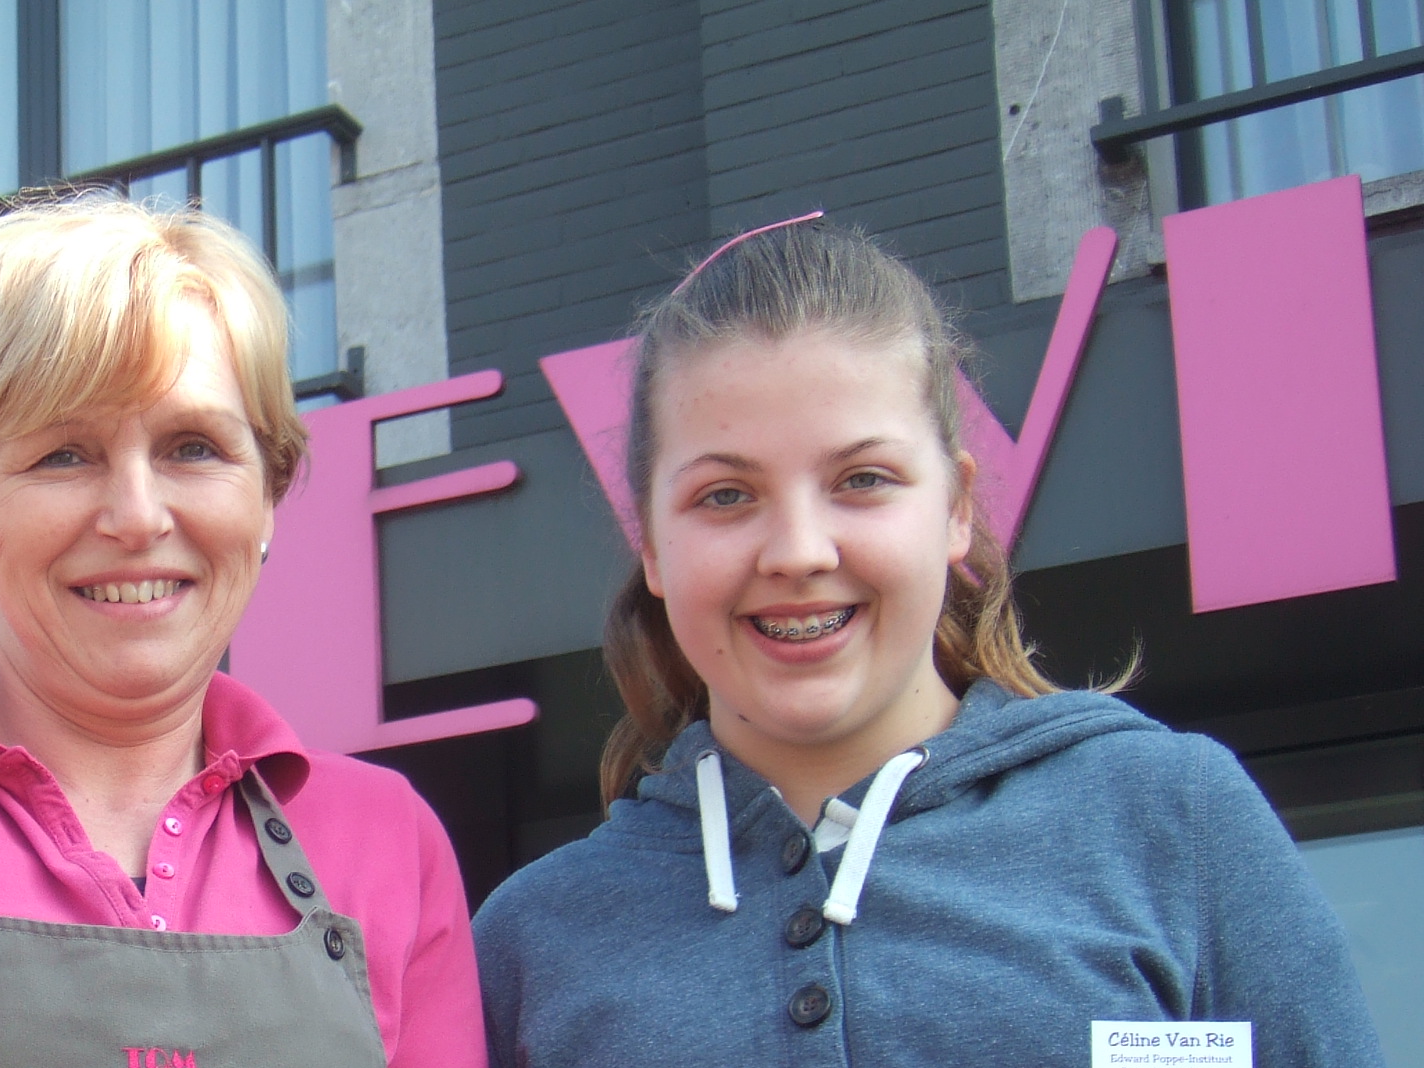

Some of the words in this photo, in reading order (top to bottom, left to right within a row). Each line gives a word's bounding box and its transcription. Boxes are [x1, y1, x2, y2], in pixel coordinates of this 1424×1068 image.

[1108, 1032, 1160, 1047] Céline
[1165, 1033, 1201, 1047] Van
[1206, 1033, 1235, 1047] Rie
[1110, 1054, 1150, 1064] Edward
[1152, 1054, 1233, 1065] Poppe-Instituut
